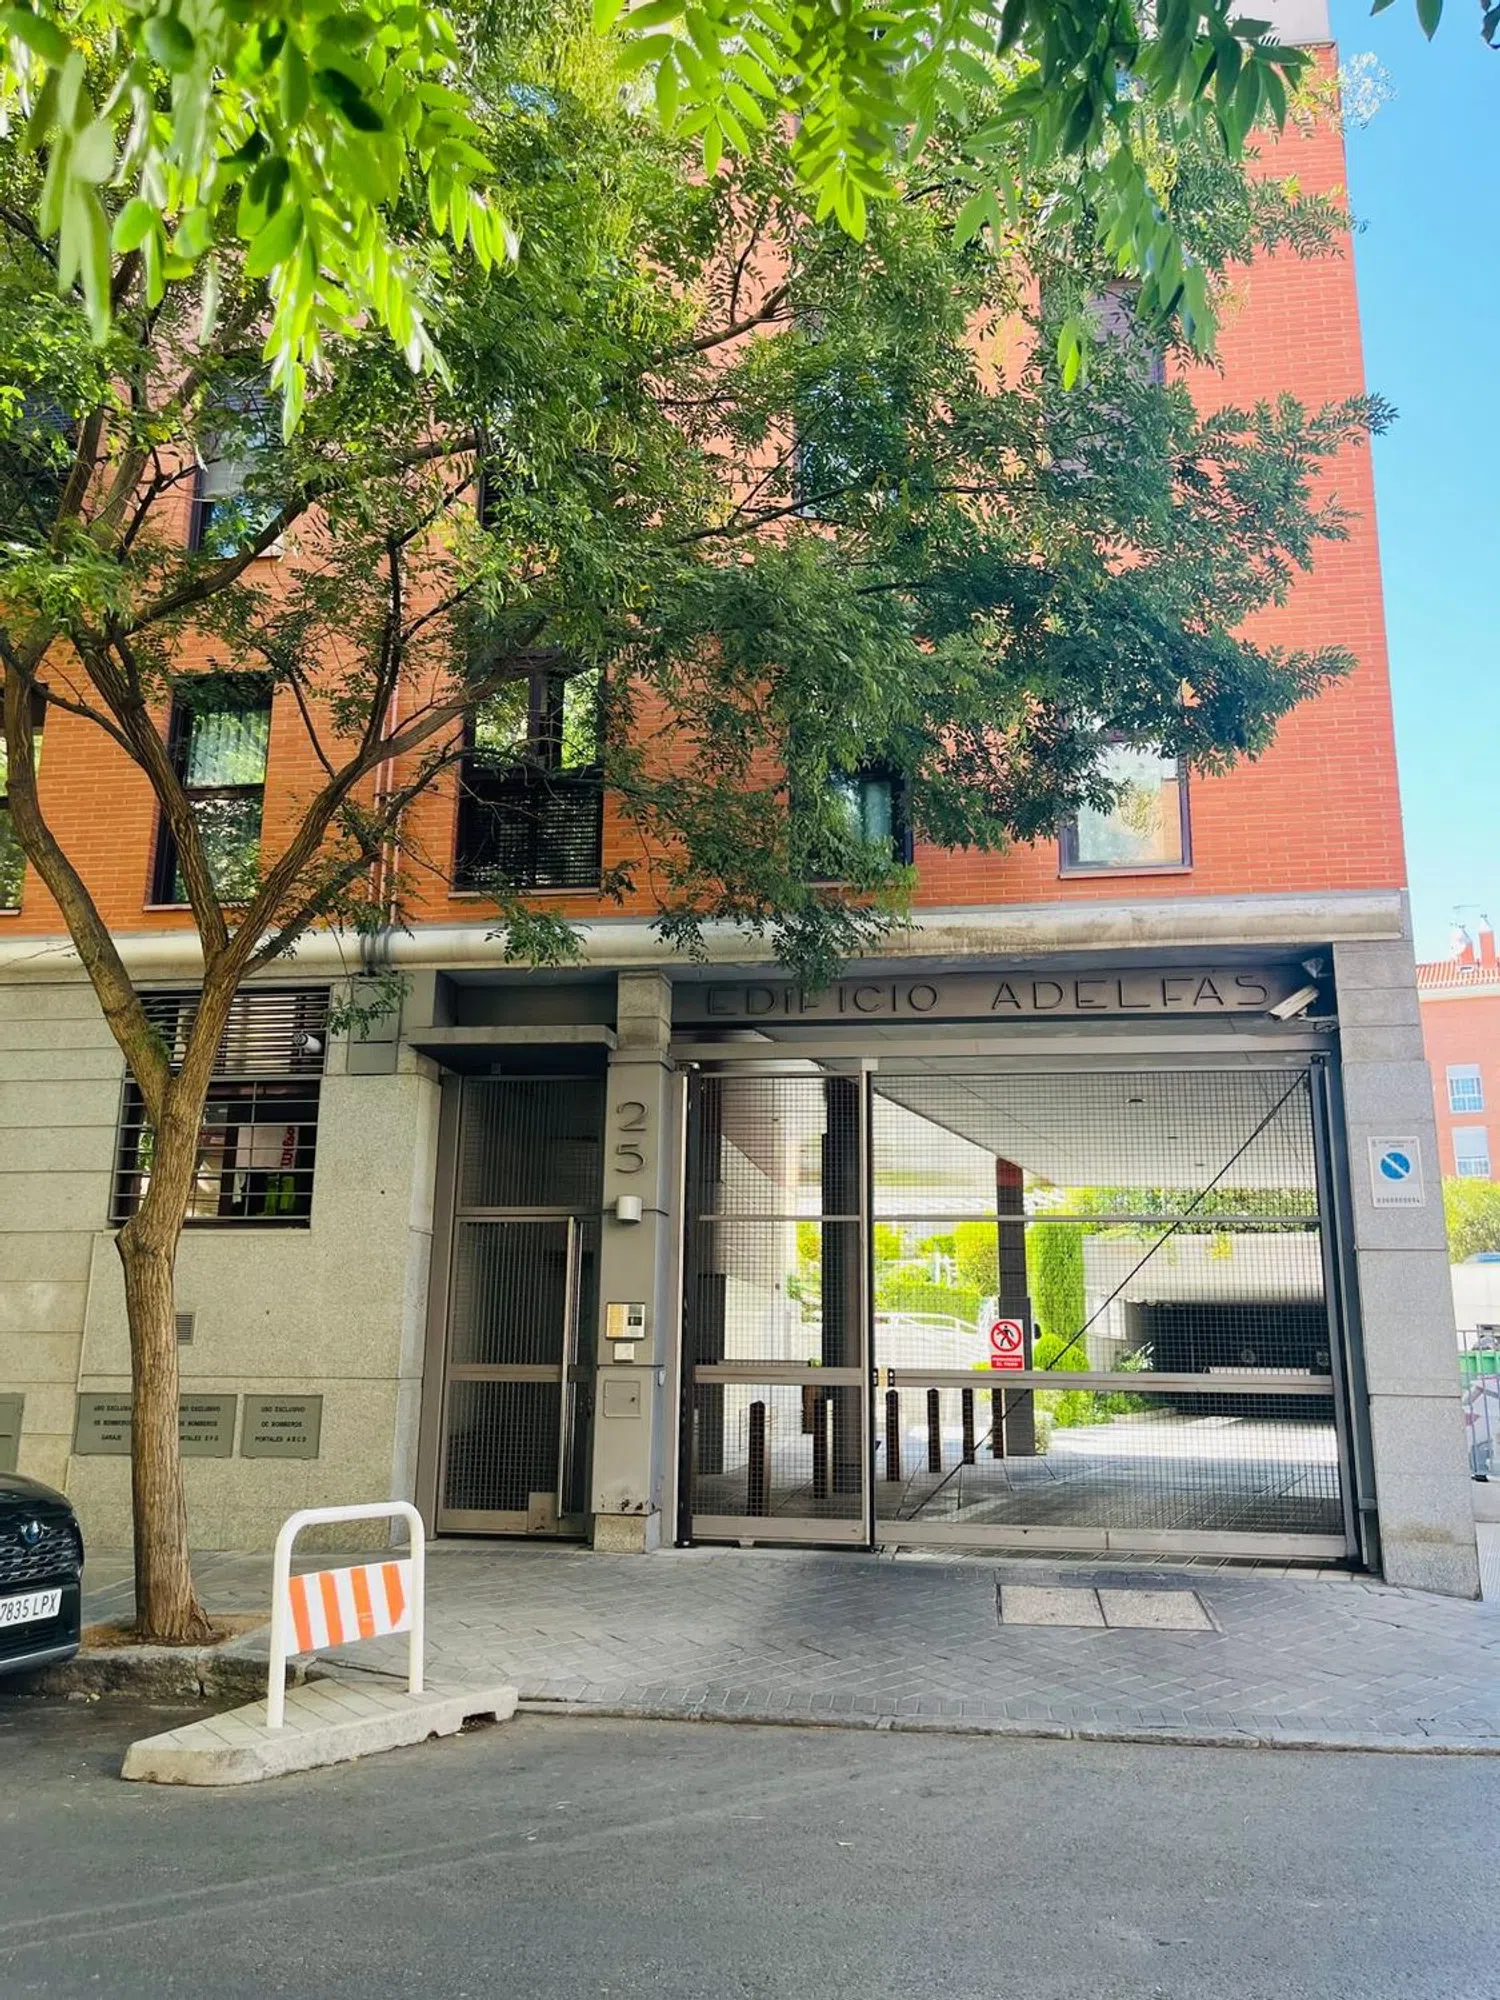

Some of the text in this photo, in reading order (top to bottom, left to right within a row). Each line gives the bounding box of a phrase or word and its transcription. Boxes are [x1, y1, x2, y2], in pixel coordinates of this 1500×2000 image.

[706, 973, 1268, 1016] EDIFICIO ADELFAS
[0, 1592, 58, 1621] 7835 LPX
